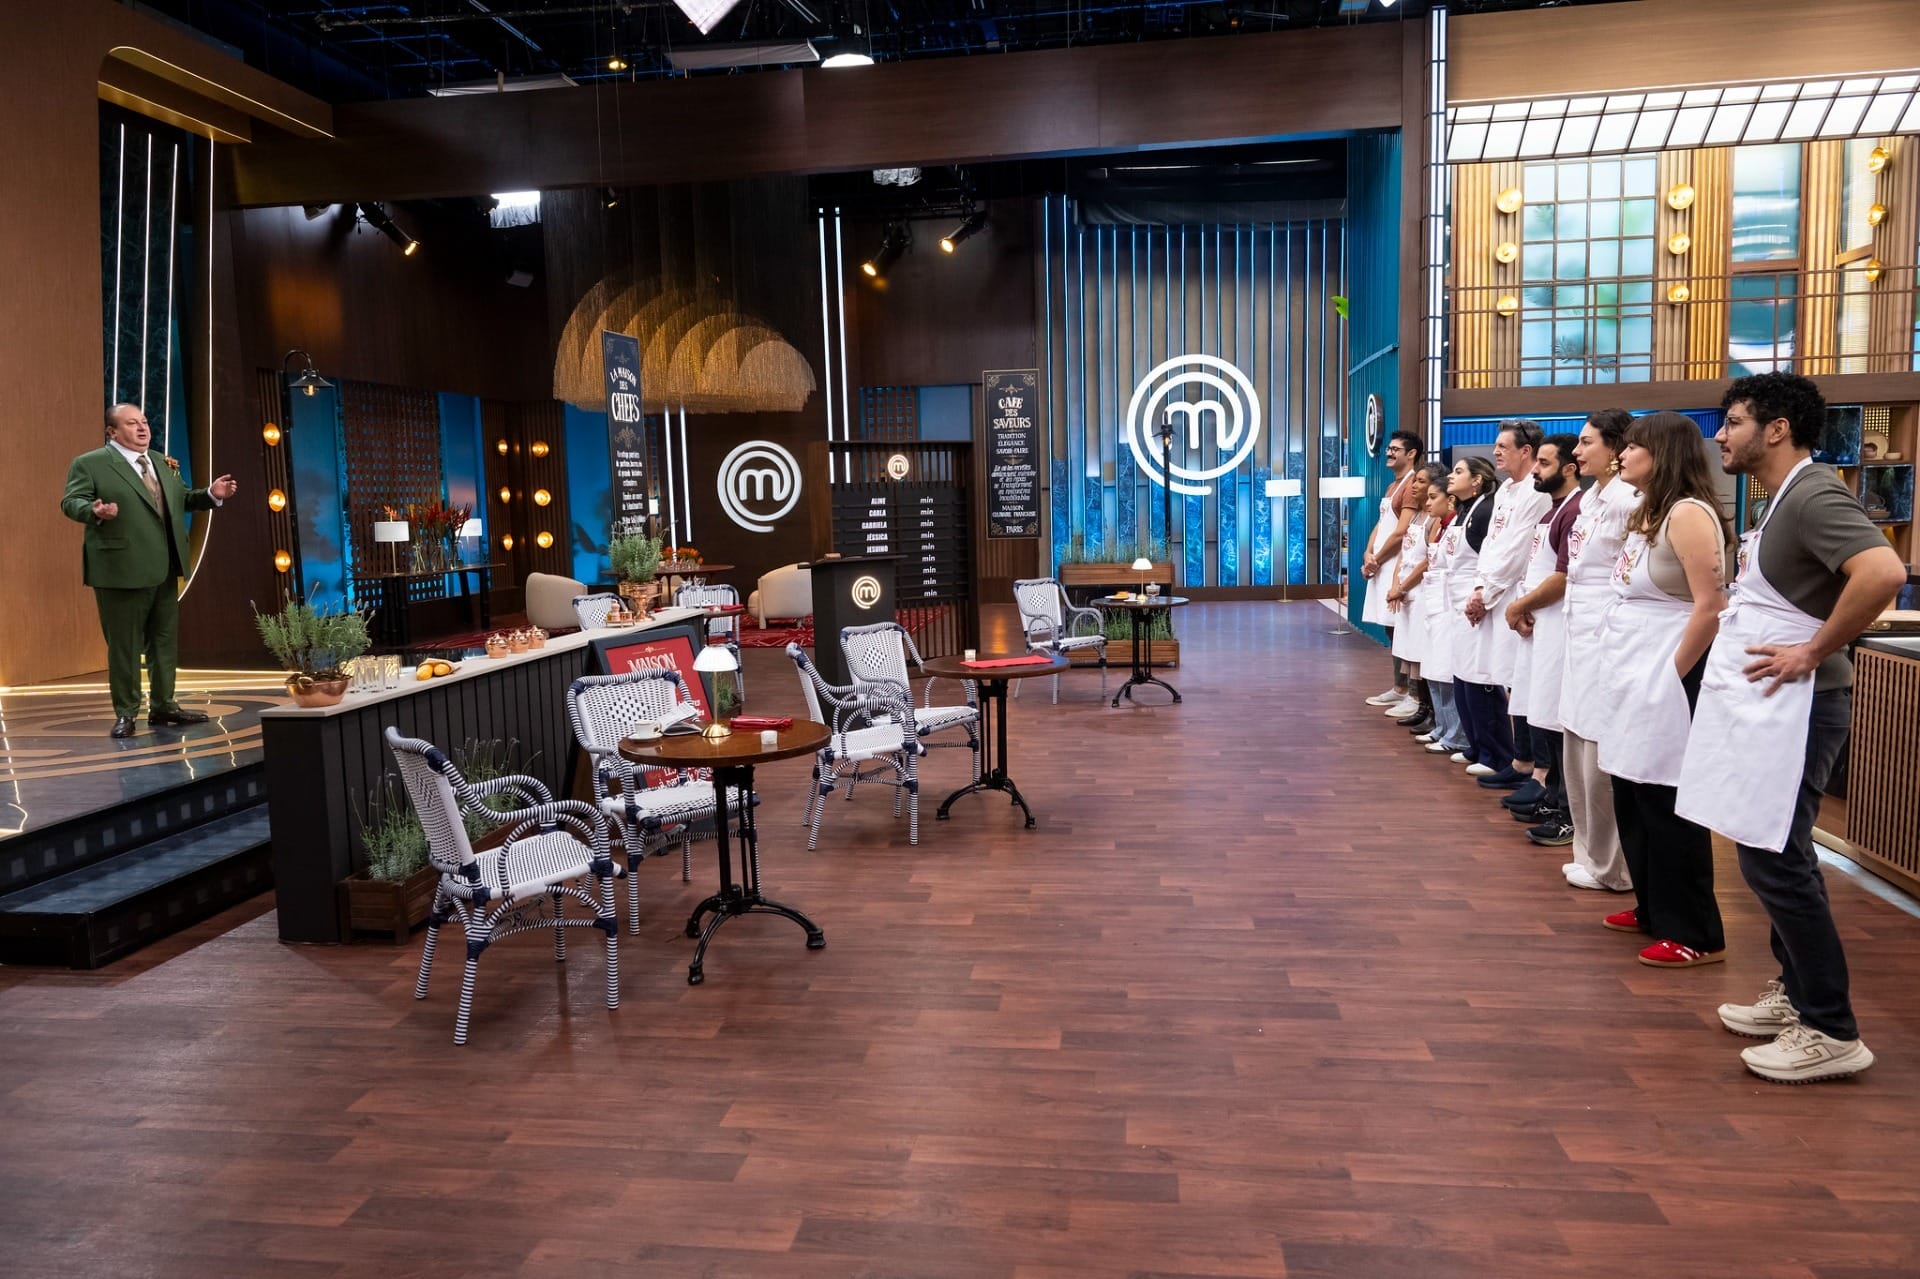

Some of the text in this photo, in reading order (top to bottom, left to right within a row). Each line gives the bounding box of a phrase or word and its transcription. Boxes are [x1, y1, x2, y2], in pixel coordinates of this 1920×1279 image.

[610, 367, 637, 387] LA MAISON
[619, 380, 628, 390] DES
[611, 392, 640, 422] CHEFS
[993, 417, 1031, 429] SAVEURS
[871, 496, 933, 505] ALINE min
[869, 508, 934, 517] CARLA min
[861, 519, 934, 529] GABRIELA min
[921, 531, 934, 539] min
[922, 554, 936, 562] min
[923, 566, 936, 574] min
[923, 577, 936, 585] min
[924, 589, 938, 597] min
[627, 652, 677, 673] MAISON
